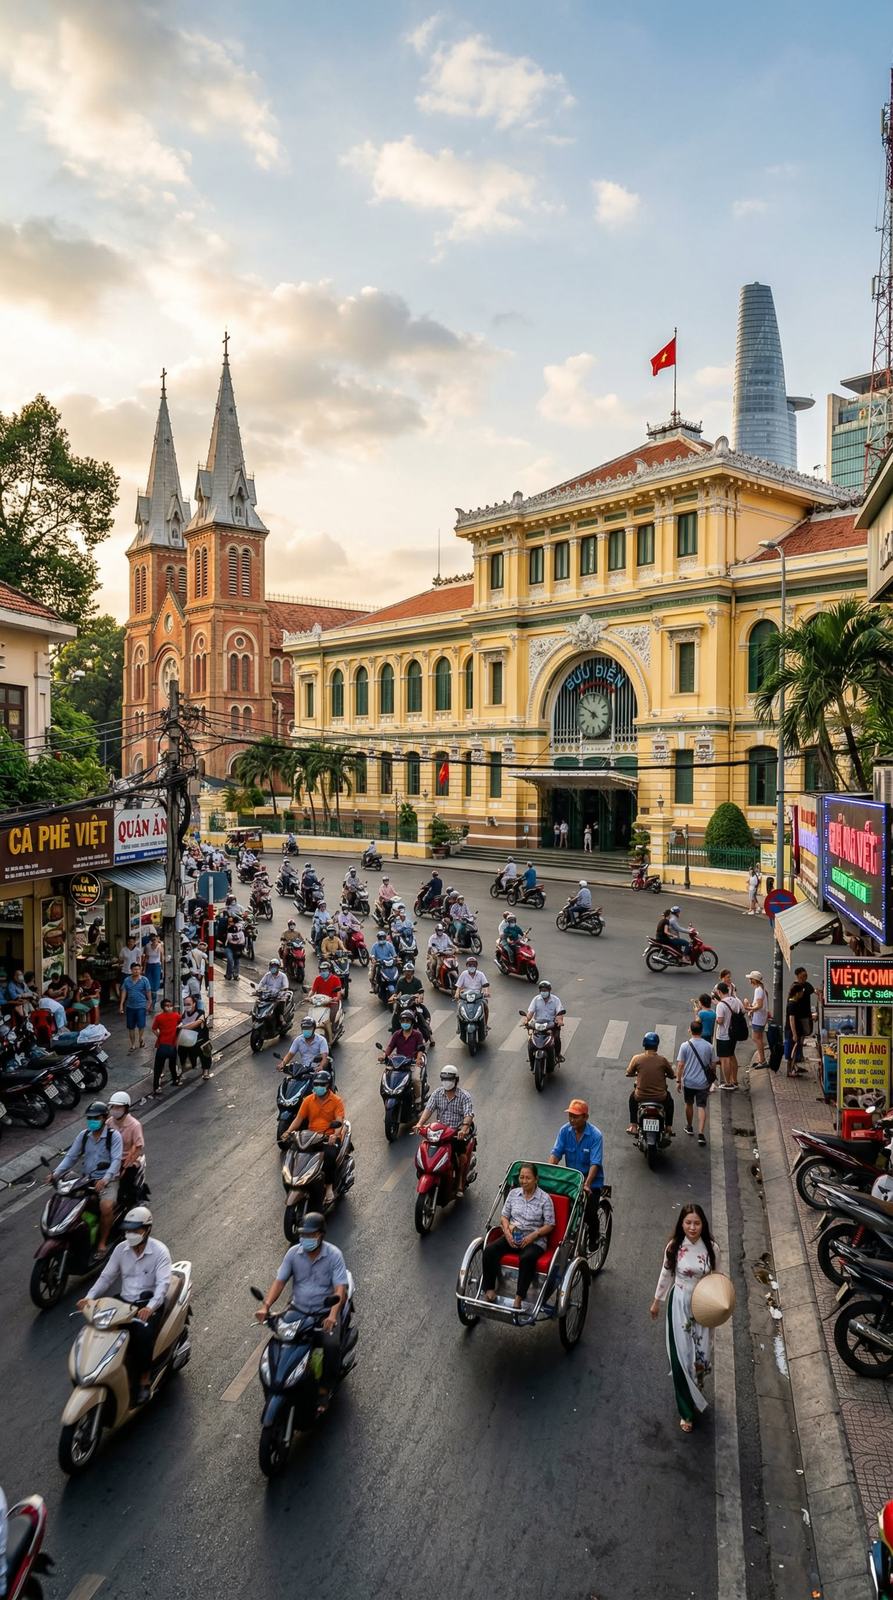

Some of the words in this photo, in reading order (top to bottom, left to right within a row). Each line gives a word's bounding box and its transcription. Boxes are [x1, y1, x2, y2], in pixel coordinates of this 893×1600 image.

[38, 816, 71, 852] PHÊ
[75, 814, 108, 849] VIỆT
[118, 813, 150, 844] QUÁN
